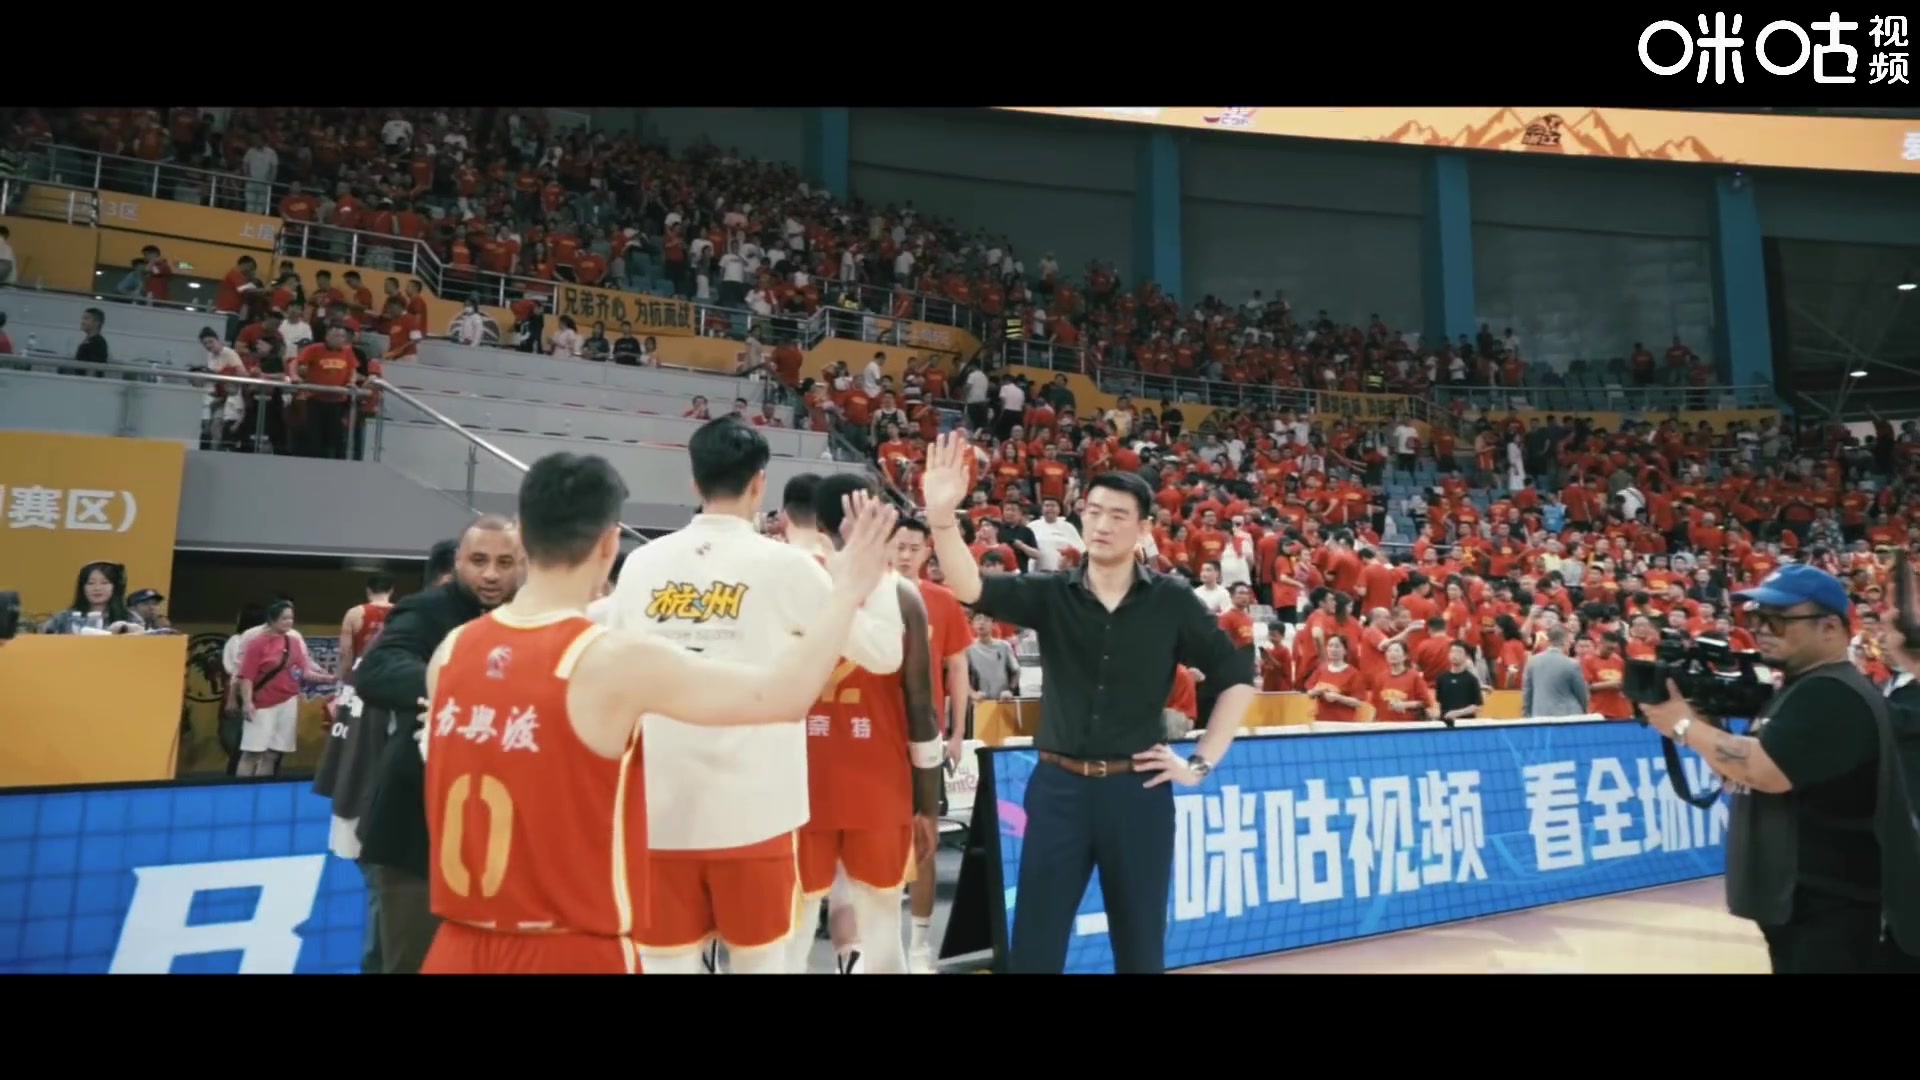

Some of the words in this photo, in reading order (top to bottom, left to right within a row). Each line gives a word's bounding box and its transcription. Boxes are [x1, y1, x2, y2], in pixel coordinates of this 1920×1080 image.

[564, 286, 627, 322] 兄弟齐心
[0, 484, 137, 533] 赛区)
[644, 580, 750, 623] 杭州
[439, 773, 514, 898] 0
[1075, 768, 1486, 936] 咪咕视频
